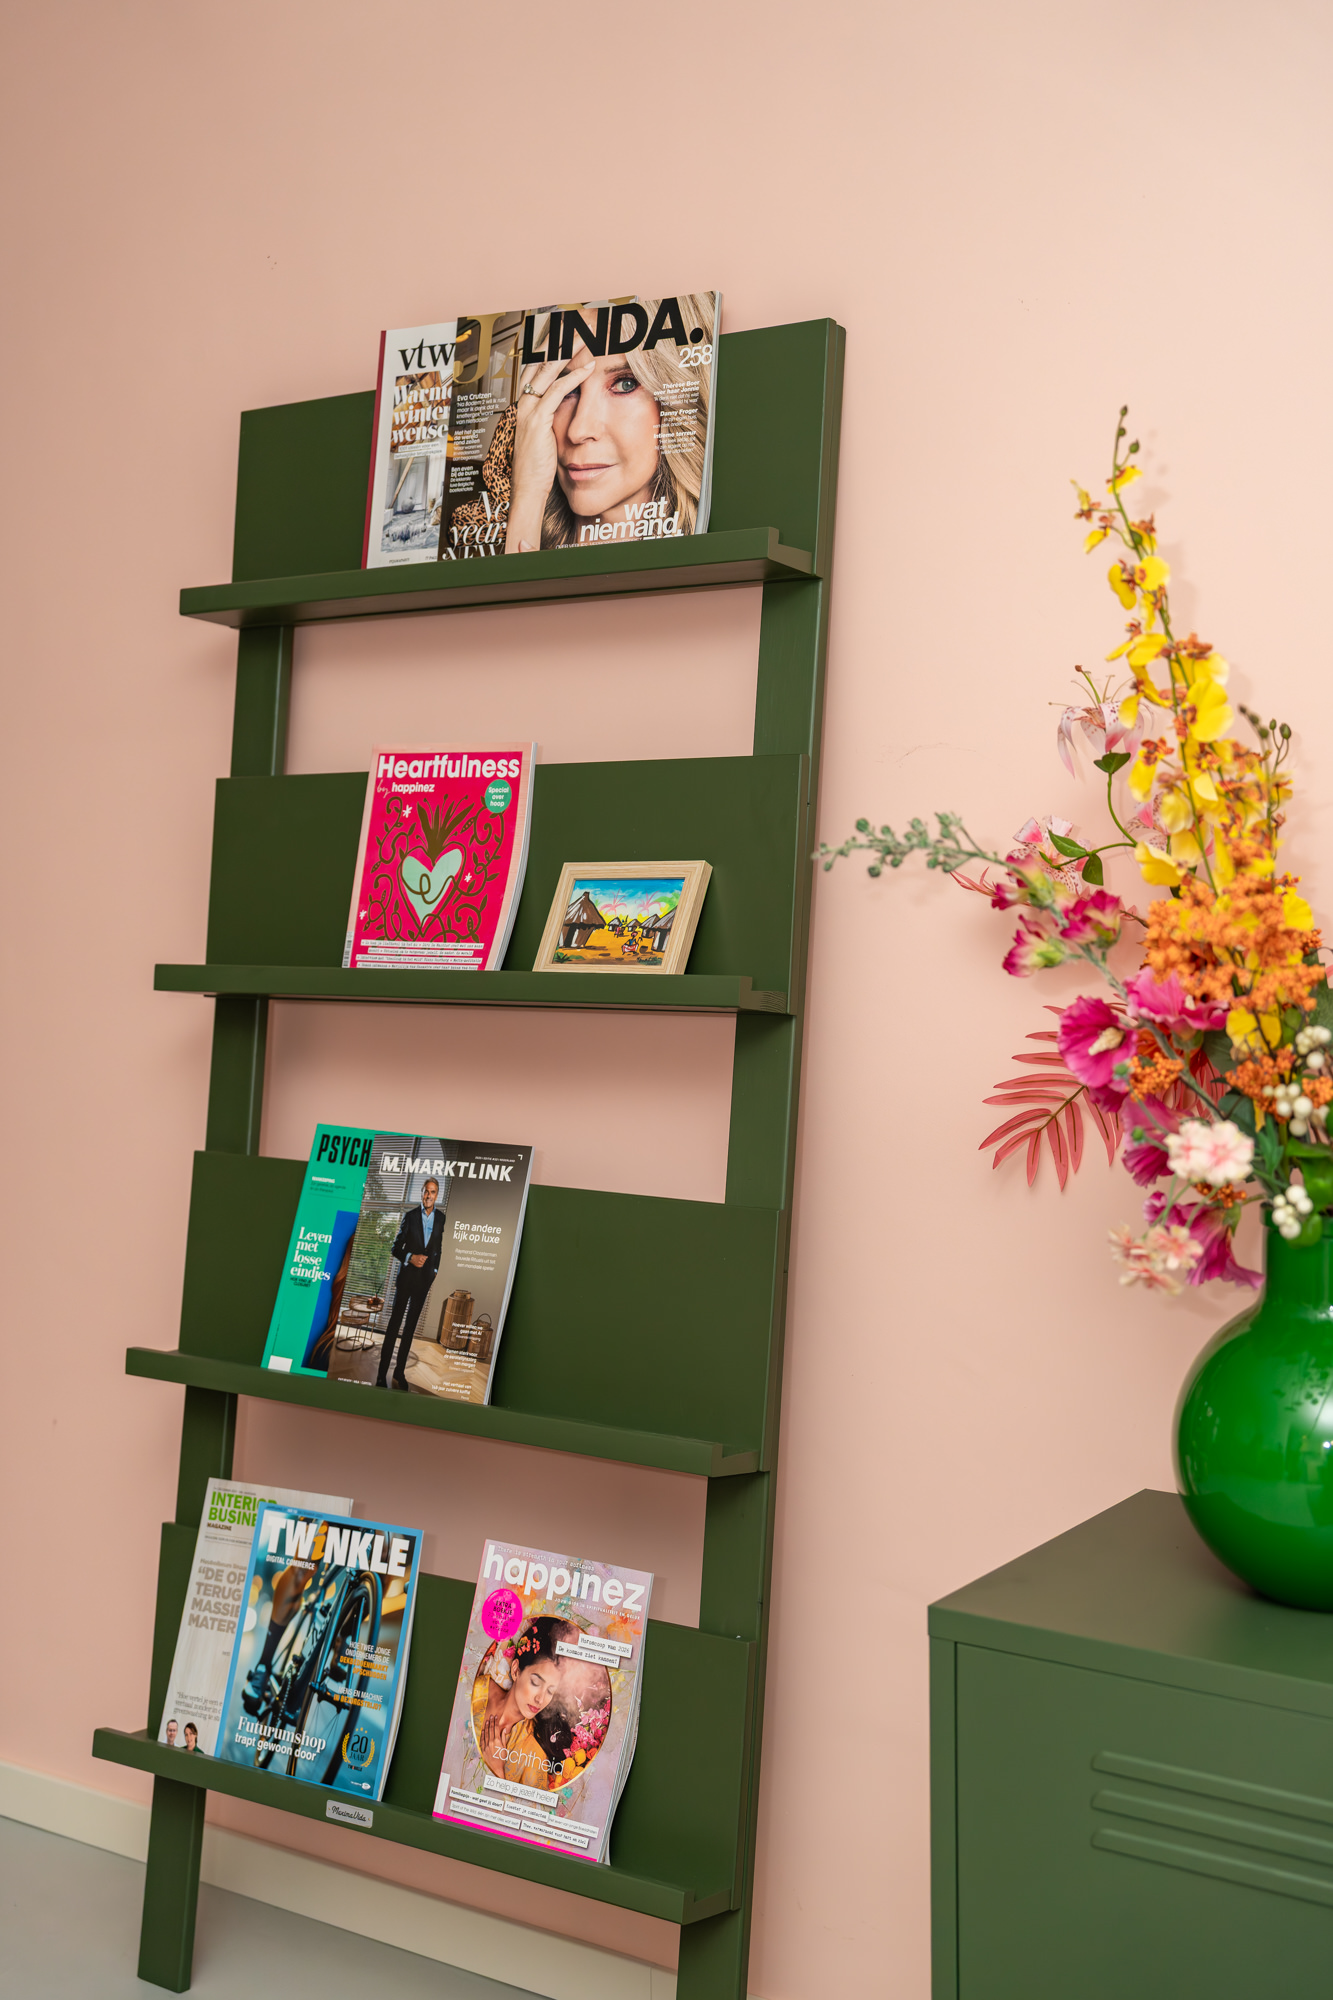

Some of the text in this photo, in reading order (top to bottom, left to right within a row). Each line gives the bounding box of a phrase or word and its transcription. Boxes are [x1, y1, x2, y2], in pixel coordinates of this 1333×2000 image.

[522, 297, 703, 364] LINDA.
[679, 344, 712, 368] 258
[679, 408, 698, 416] Froger
[473, 428, 486, 436] gezin
[624, 496, 667, 520] wat
[377, 754, 520, 778] Heartfulness
[391, 781, 435, 795] happinez
[490, 800, 505, 808] hoop
[317, 1134, 373, 1167] PSYCH
[404, 1158, 514, 1182] MARKTLINK
[299, 1226, 332, 1243] Leven
[454, 1221, 502, 1234] Een andere
[453, 1231, 500, 1243] kijk op luxe
[296, 1240, 319, 1252] met
[293, 1250, 322, 1266] losse
[290, 1264, 331, 1282] eindjes
[207, 1522, 232, 1531] MAGAZINE
[266, 1555, 315, 1570] DIGITAL COMMERCE
[569, 1561, 595, 1571] softness
[483, 1544, 645, 1611] happinez
[195, 1582, 242, 1601] TERUG
[493, 1606, 512, 1615] BOEKJE
[496, 1600, 512, 1608] EXTRA
[188, 1614, 236, 1634] MATER
[349, 1641, 391, 1656] HOE TWEE JONGE
[581, 1638, 605, 1648] Horoscoop
[345, 1649, 390, 1664] ONDERNEMERS DE
[566, 1647, 583, 1656] kosmos
[352, 1667, 387, 1680] OPSCHUDDEN
[333, 1693, 340, 1701] IN
[338, 1686, 383, 1702] MENS EN MACHINE
[237, 1716, 326, 1752] Futurumshop
[235, 1732, 317, 1761] trapt gewoon door
[351, 1734, 368, 1754] 20
[349, 1752, 364, 1761] JAAR
[492, 1746, 565, 1776] zachtheid
[486, 1777, 555, 1803] Zo help je jezelf helen
